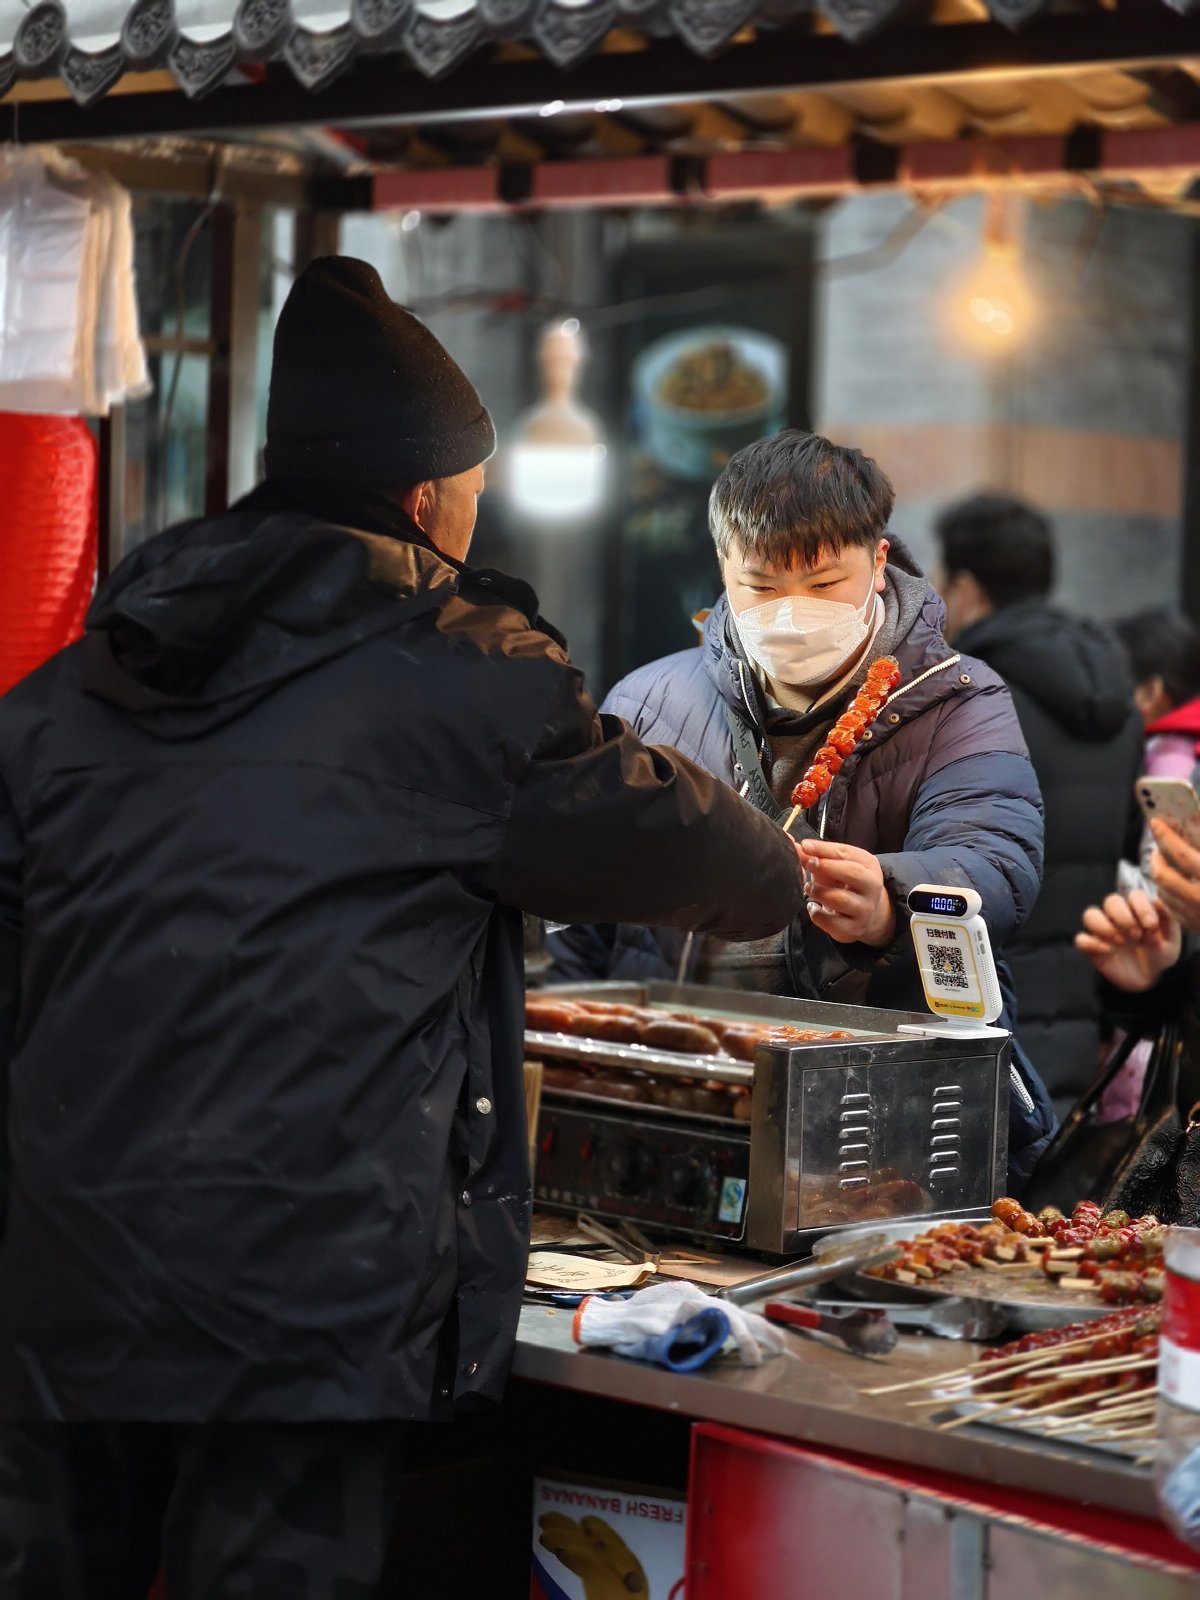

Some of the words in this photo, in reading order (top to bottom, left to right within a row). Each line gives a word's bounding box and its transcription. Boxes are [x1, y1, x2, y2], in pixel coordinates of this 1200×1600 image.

[926, 928, 957, 940] 扫我付款
[540, 1486, 621, 1513] BANANAS
[626, 1500, 684, 1523] FRESH
